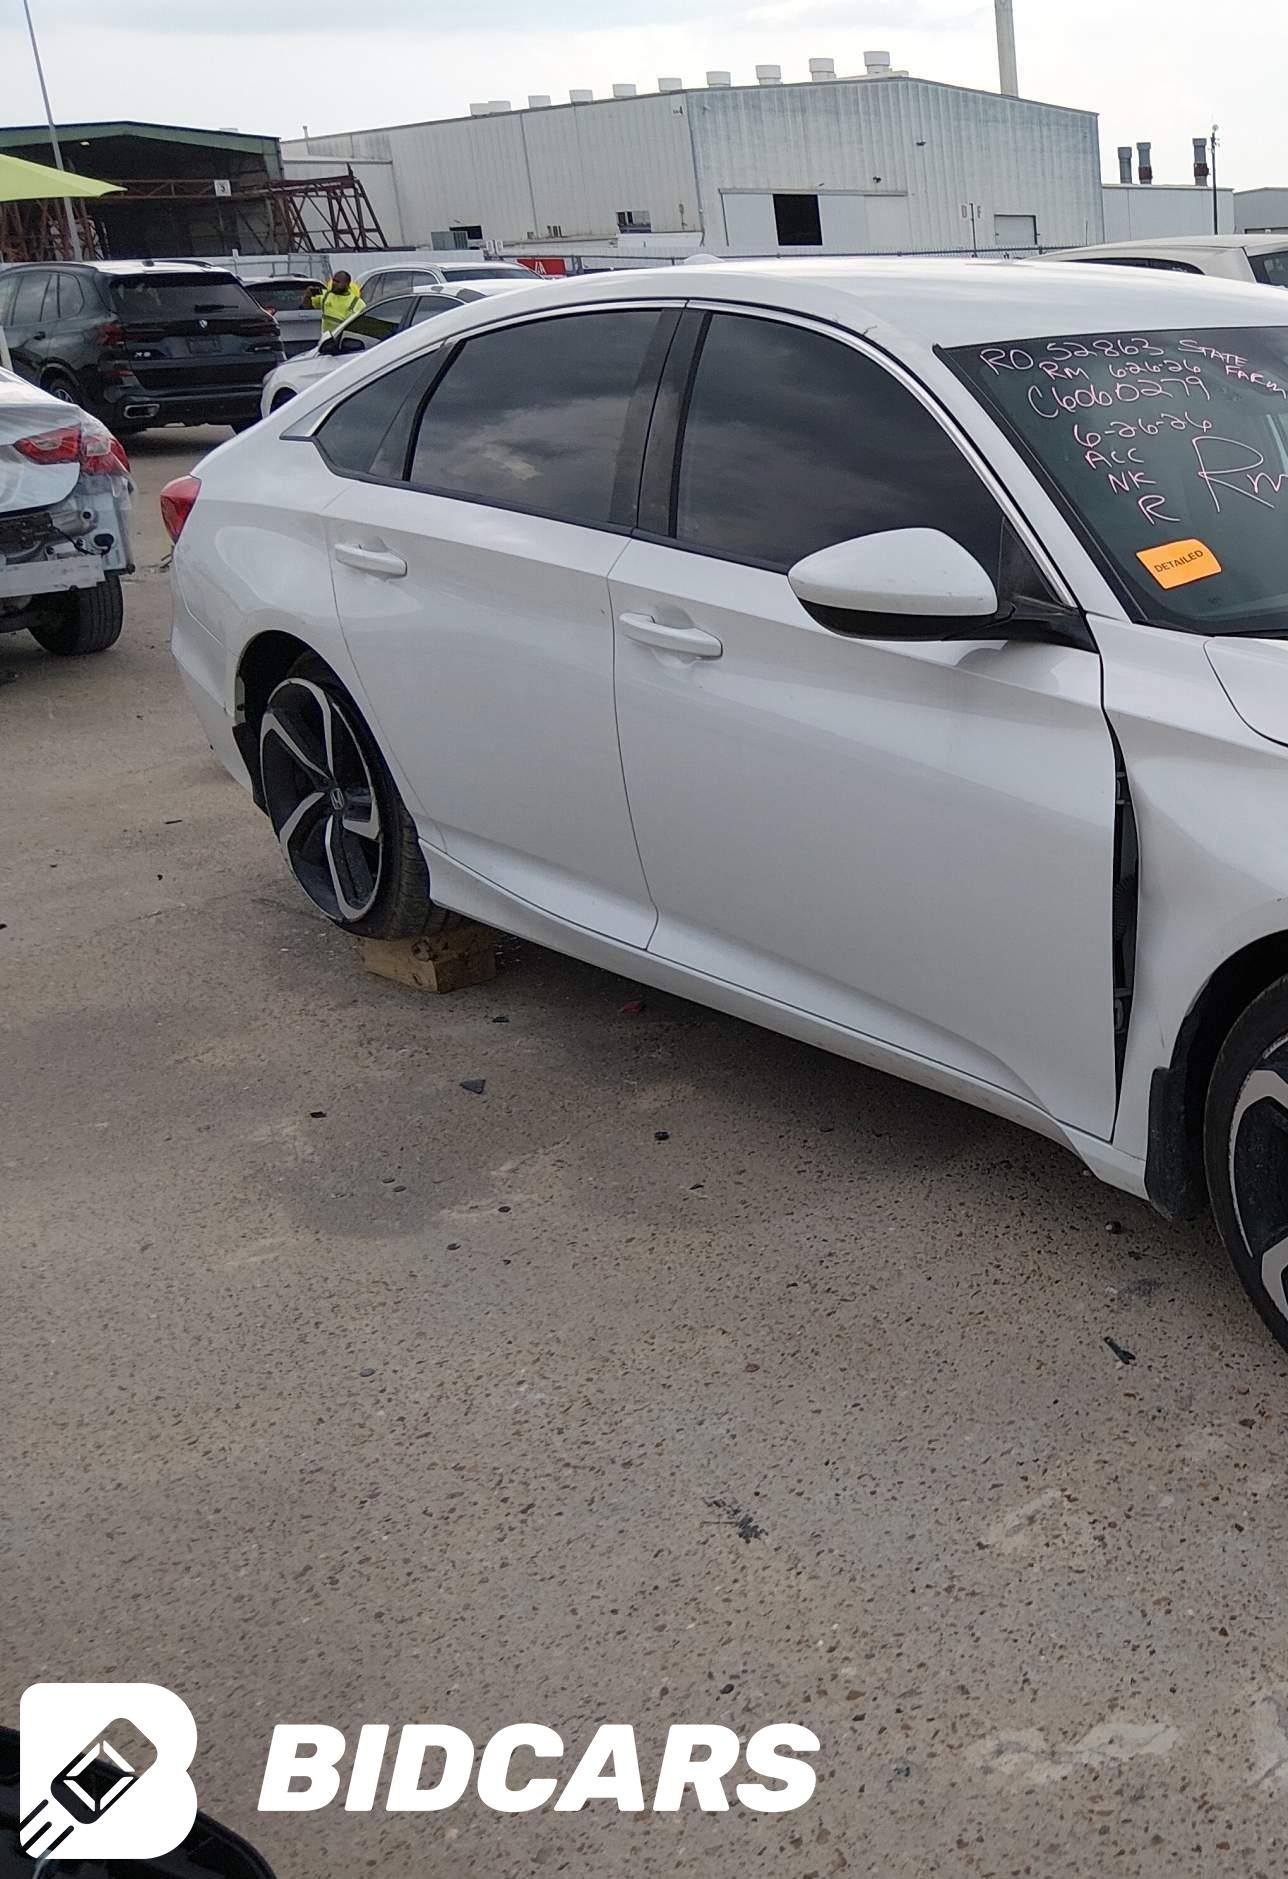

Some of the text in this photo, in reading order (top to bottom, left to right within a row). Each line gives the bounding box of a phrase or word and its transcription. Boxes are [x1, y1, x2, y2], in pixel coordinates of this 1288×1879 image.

[1177, 339, 1249, 366] STATE
[1084, 447, 1145, 470] ACC
[1107, 470, 1158, 495] NK
[1137, 494, 1182, 526] R
[1153, 549, 1204, 574] DETAILED
